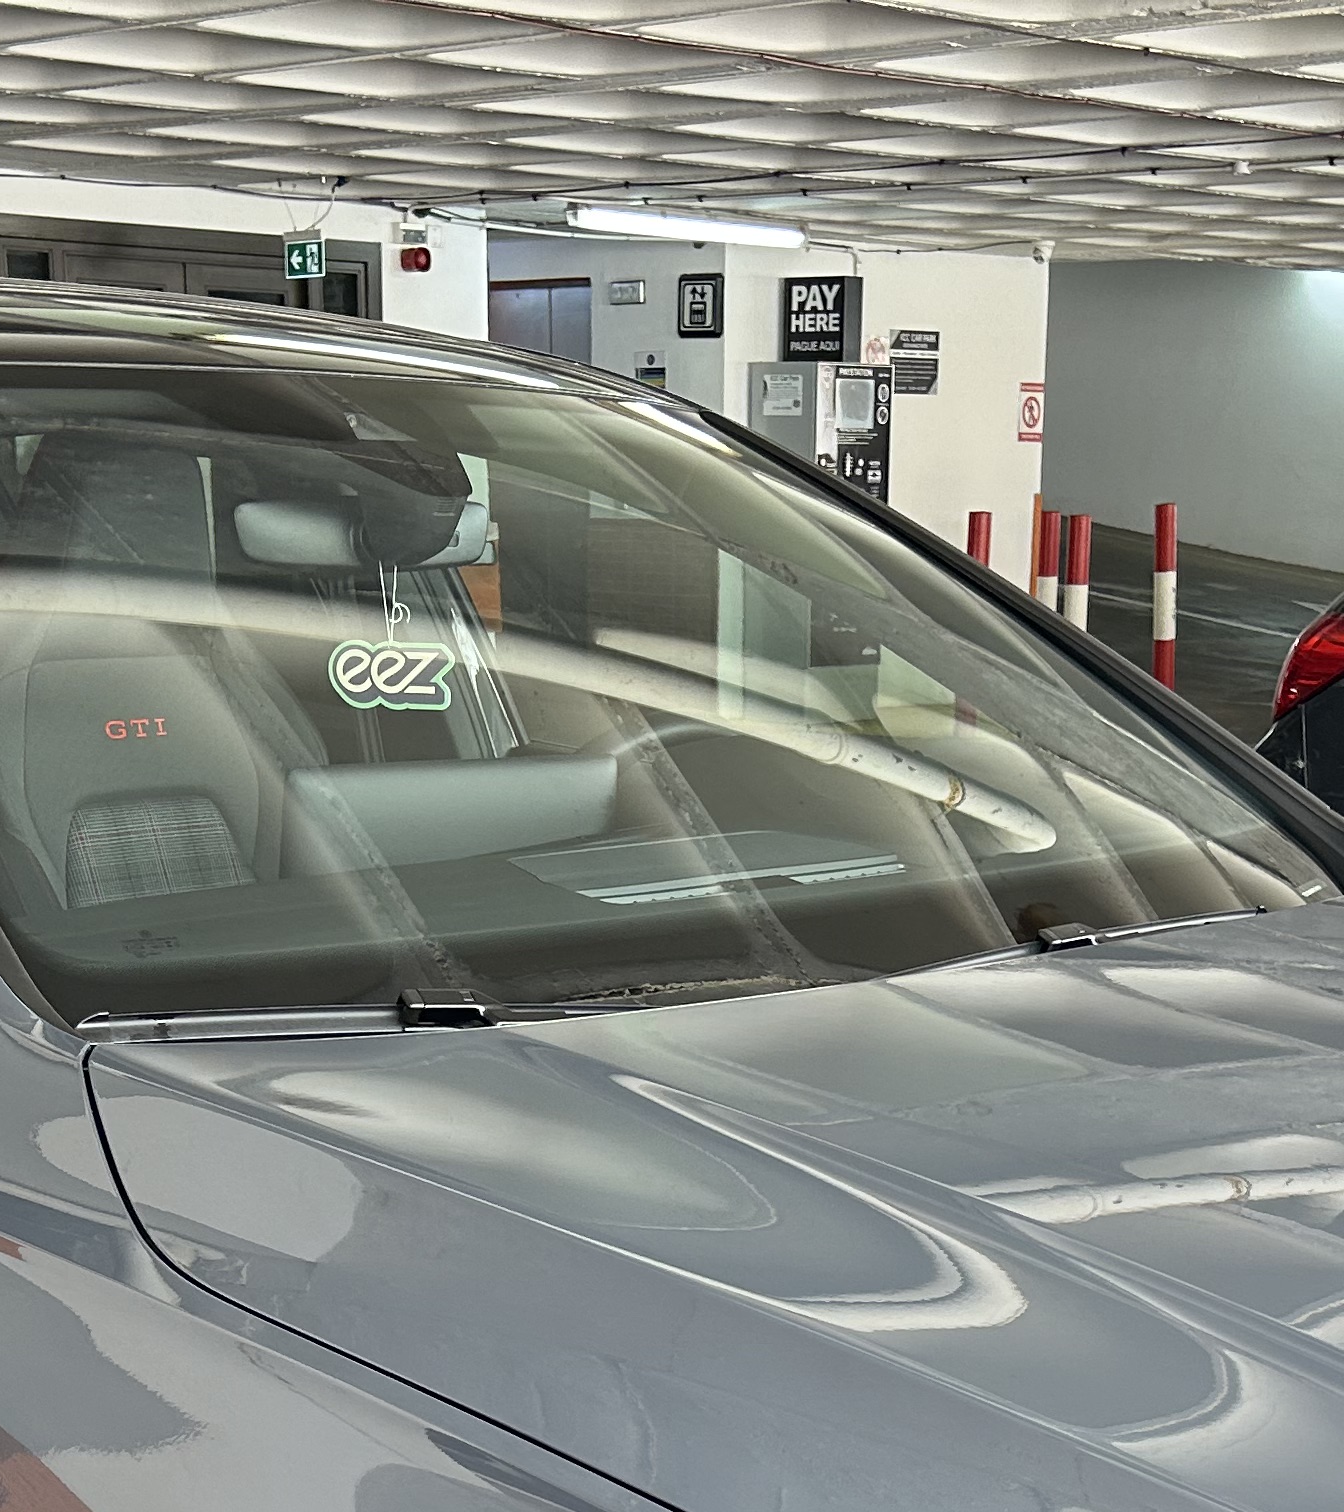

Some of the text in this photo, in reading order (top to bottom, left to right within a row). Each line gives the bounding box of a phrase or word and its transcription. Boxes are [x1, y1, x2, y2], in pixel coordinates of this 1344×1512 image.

[791, 284, 841, 311] PAY
[790, 313, 840, 332] HERE
[789, 340, 818, 352] PAGUE
[336, 648, 439, 694] eez
[105, 718, 167, 739] GTI
